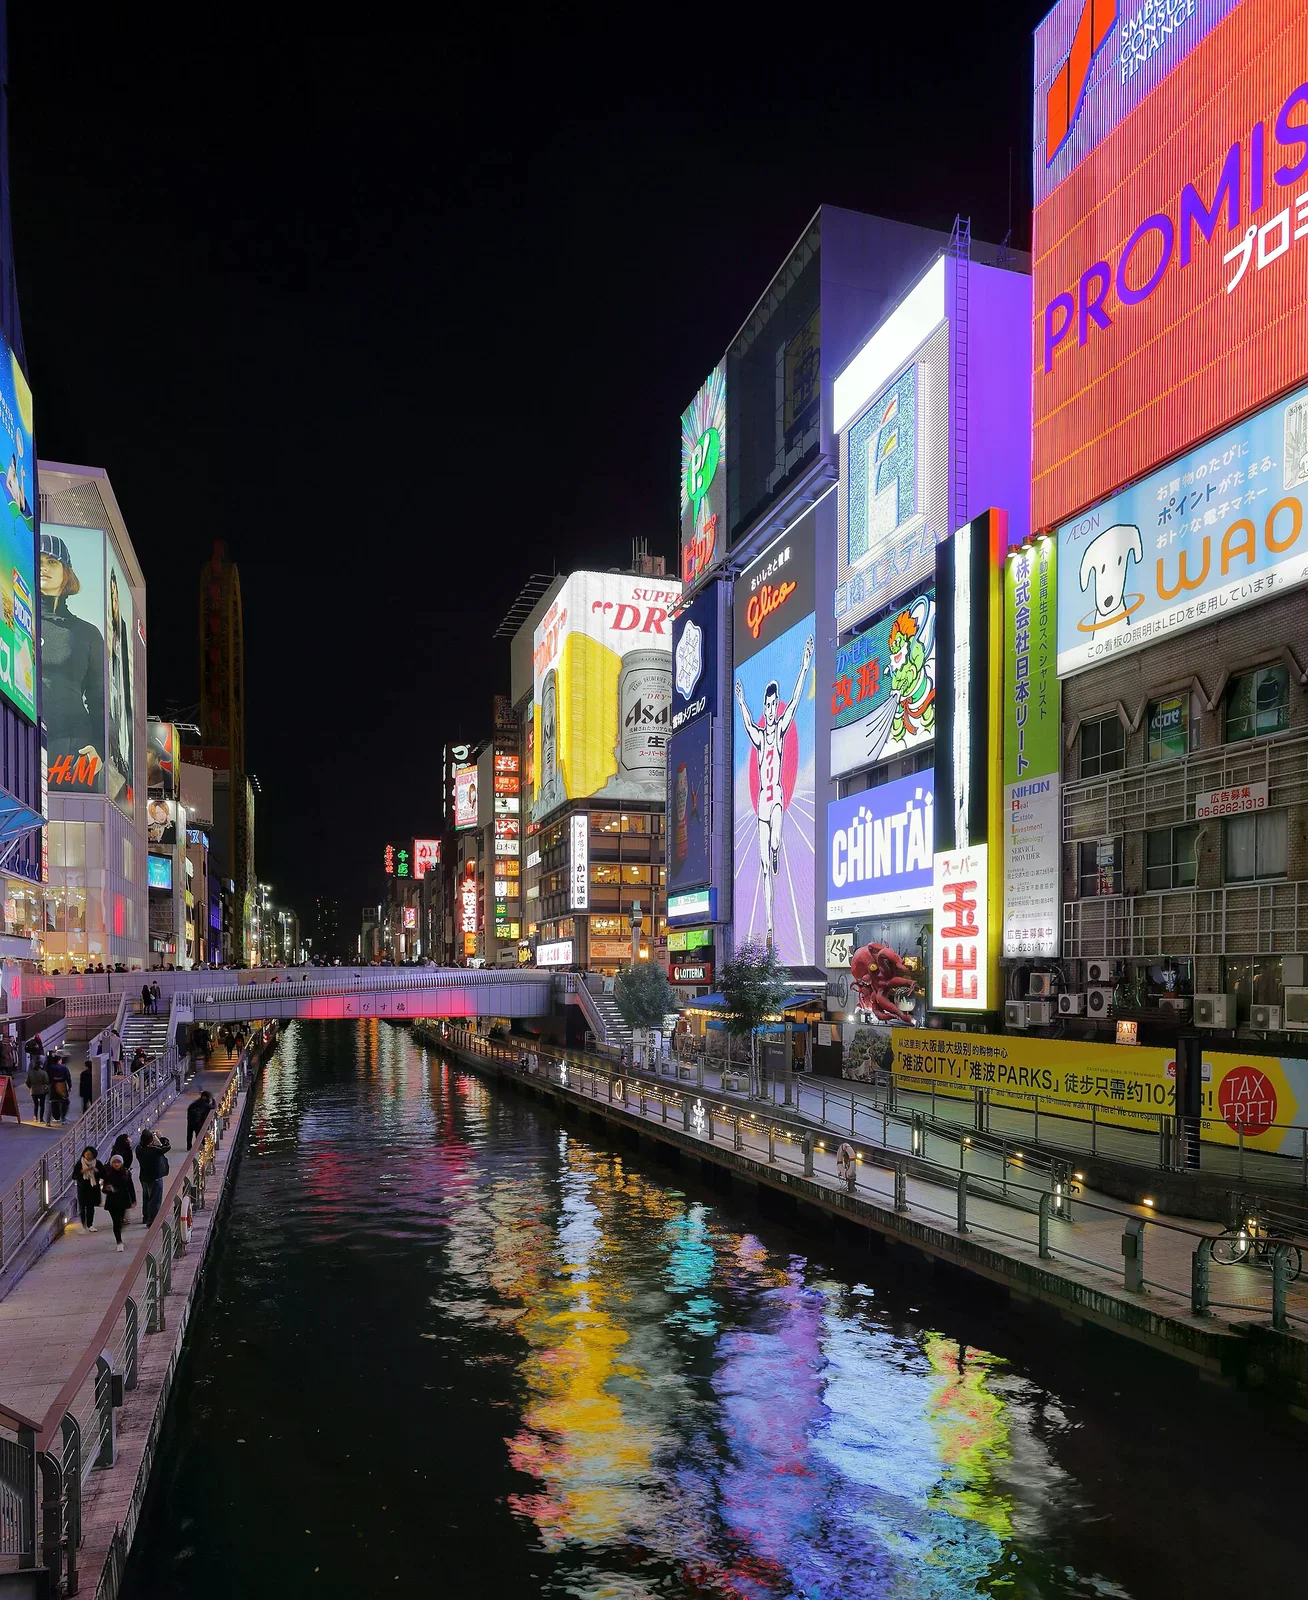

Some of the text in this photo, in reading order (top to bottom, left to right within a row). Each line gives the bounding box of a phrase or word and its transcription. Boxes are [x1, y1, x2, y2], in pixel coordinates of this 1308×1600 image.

[1157, 440, 1250, 500] お買物のたびに
[1156, 487, 1268, 549] おトクな電子マネー
[683, 513, 718, 583] ピップ
[632, 587, 684, 603] SUPER
[746, 581, 798, 639] Glico
[1087, 572, 1284, 658] この看板の照明はLEDを使用しています。
[1039, 547, 1049, 720] 不動産再生のスペシャリスト
[836, 634, 880, 673] かぜに
[1014, 556, 1031, 776] 株式会社日本リート
[831, 656, 882, 716] 改源
[647, 736, 666, 749] 生
[47, 754, 98, 787] H&M
[648, 769, 665, 778] 350ml
[765, 747, 775, 802] グリコ
[1011, 780, 1050, 800] NIHON
[1209, 786, 1251, 804] 広告募集
[1011, 812, 1034, 823] Estate
[1197, 797, 1266, 818] 06-6262-1313
[832, 788, 934, 888] CHINTAI
[1011, 823, 1043, 835] Investment
[496, 841, 517, 851] 白木屋
[1011, 834, 1045, 846] Technology
[1011, 844, 1036, 855] SERVICE
[942, 856, 979, 877] スーパー
[1011, 852, 1041, 863] PROVIDER
[461, 879, 476, 932] 大阪王将
[940, 881, 979, 1000] 玉出
[1007, 928, 1053, 940] 広告主募集中
[1006, 941, 1054, 953] 06-6281-1717
[680, 968, 704, 979] LOTTERIA
[1117, 1022, 1137, 1034] BAR
[1226, 1074, 1265, 1101] TAX
[1223, 1100, 1274, 1126] FREE!
